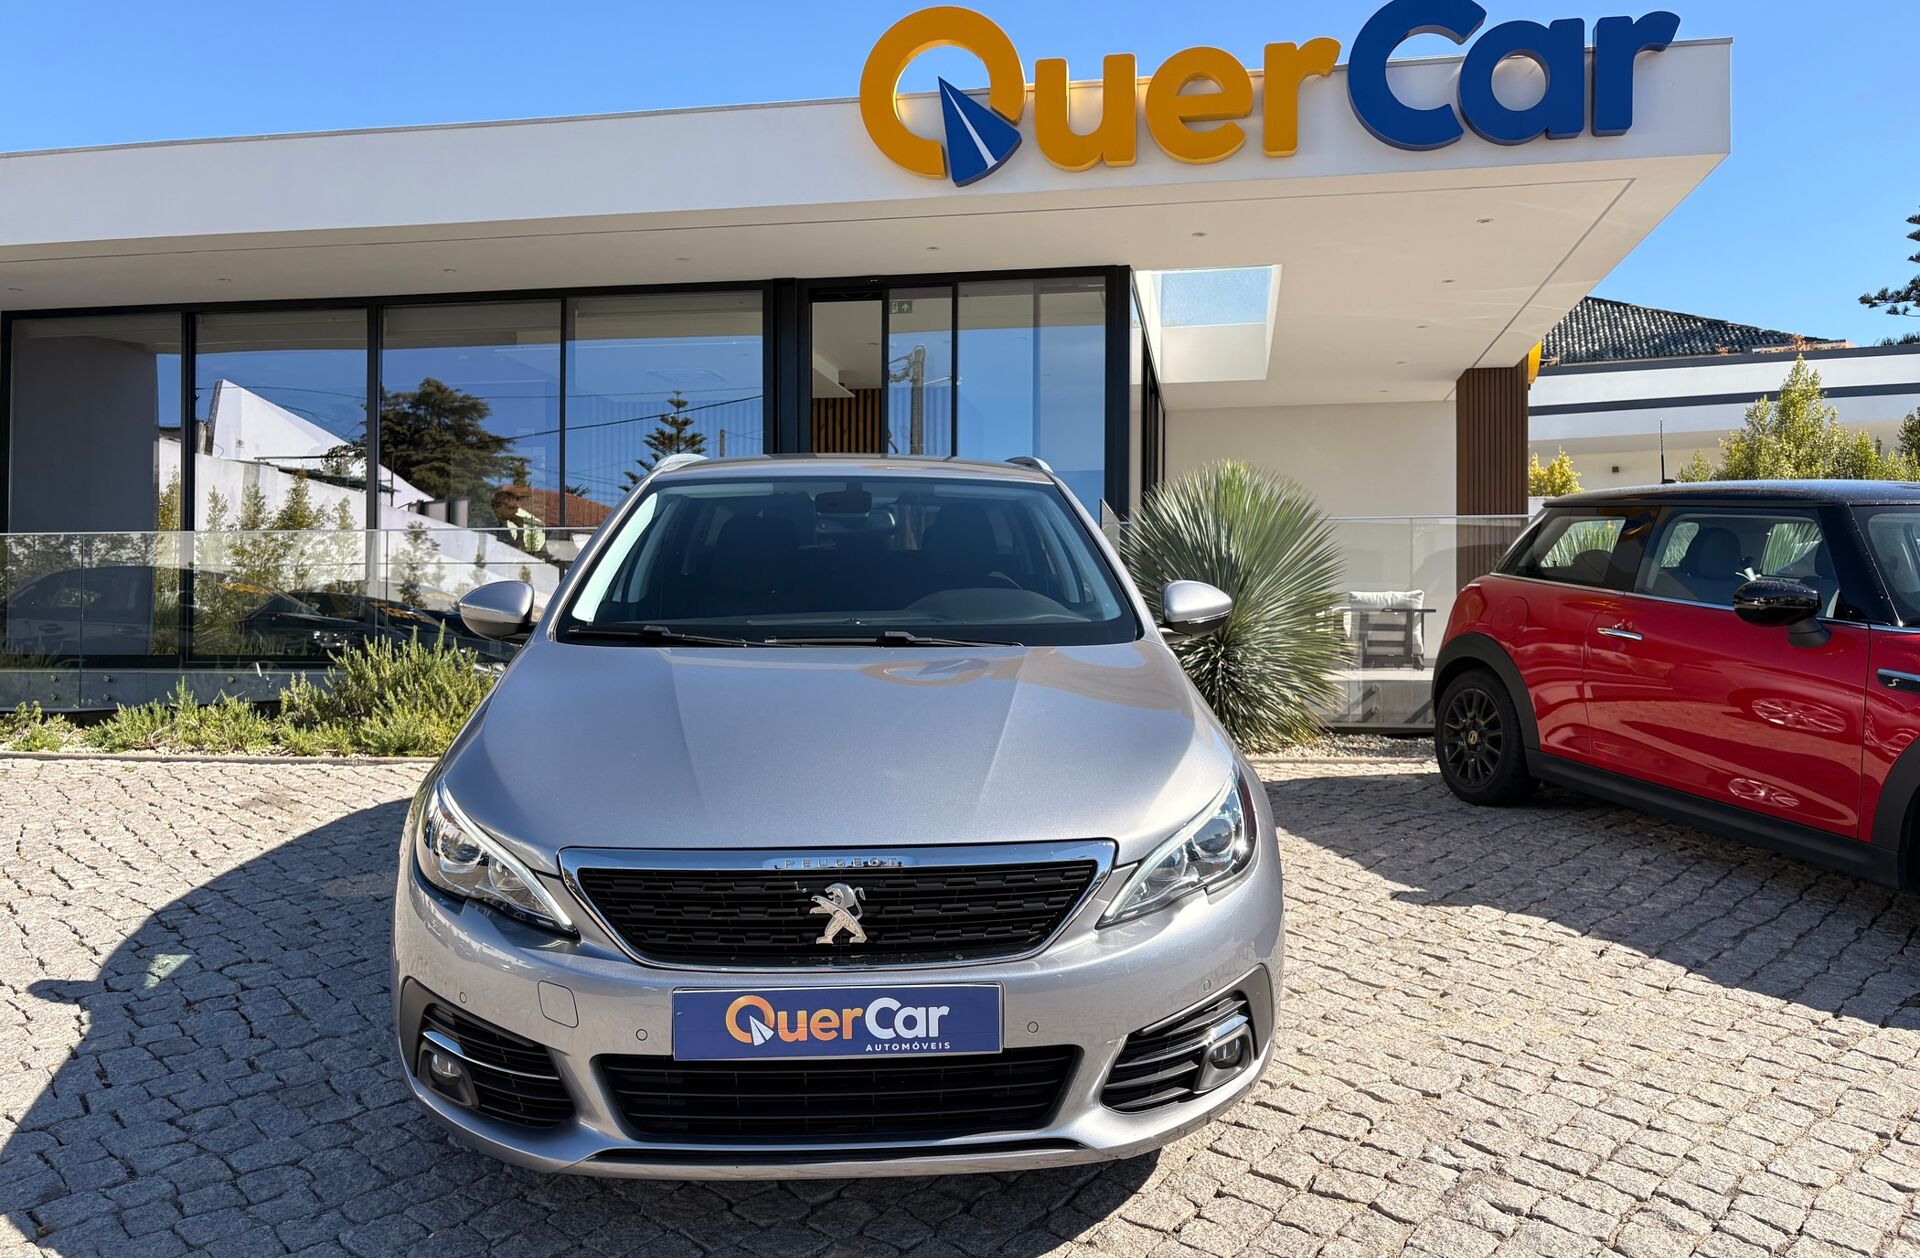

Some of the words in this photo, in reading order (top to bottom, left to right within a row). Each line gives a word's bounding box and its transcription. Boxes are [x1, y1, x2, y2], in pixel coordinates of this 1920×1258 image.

[859, 0, 1680, 187] QuerCar
[784, 857, 897, 869] PEUGEOT
[725, 995, 949, 1046] QuerCar
[865, 1039, 951, 1052] AUTOMÓVEIS
